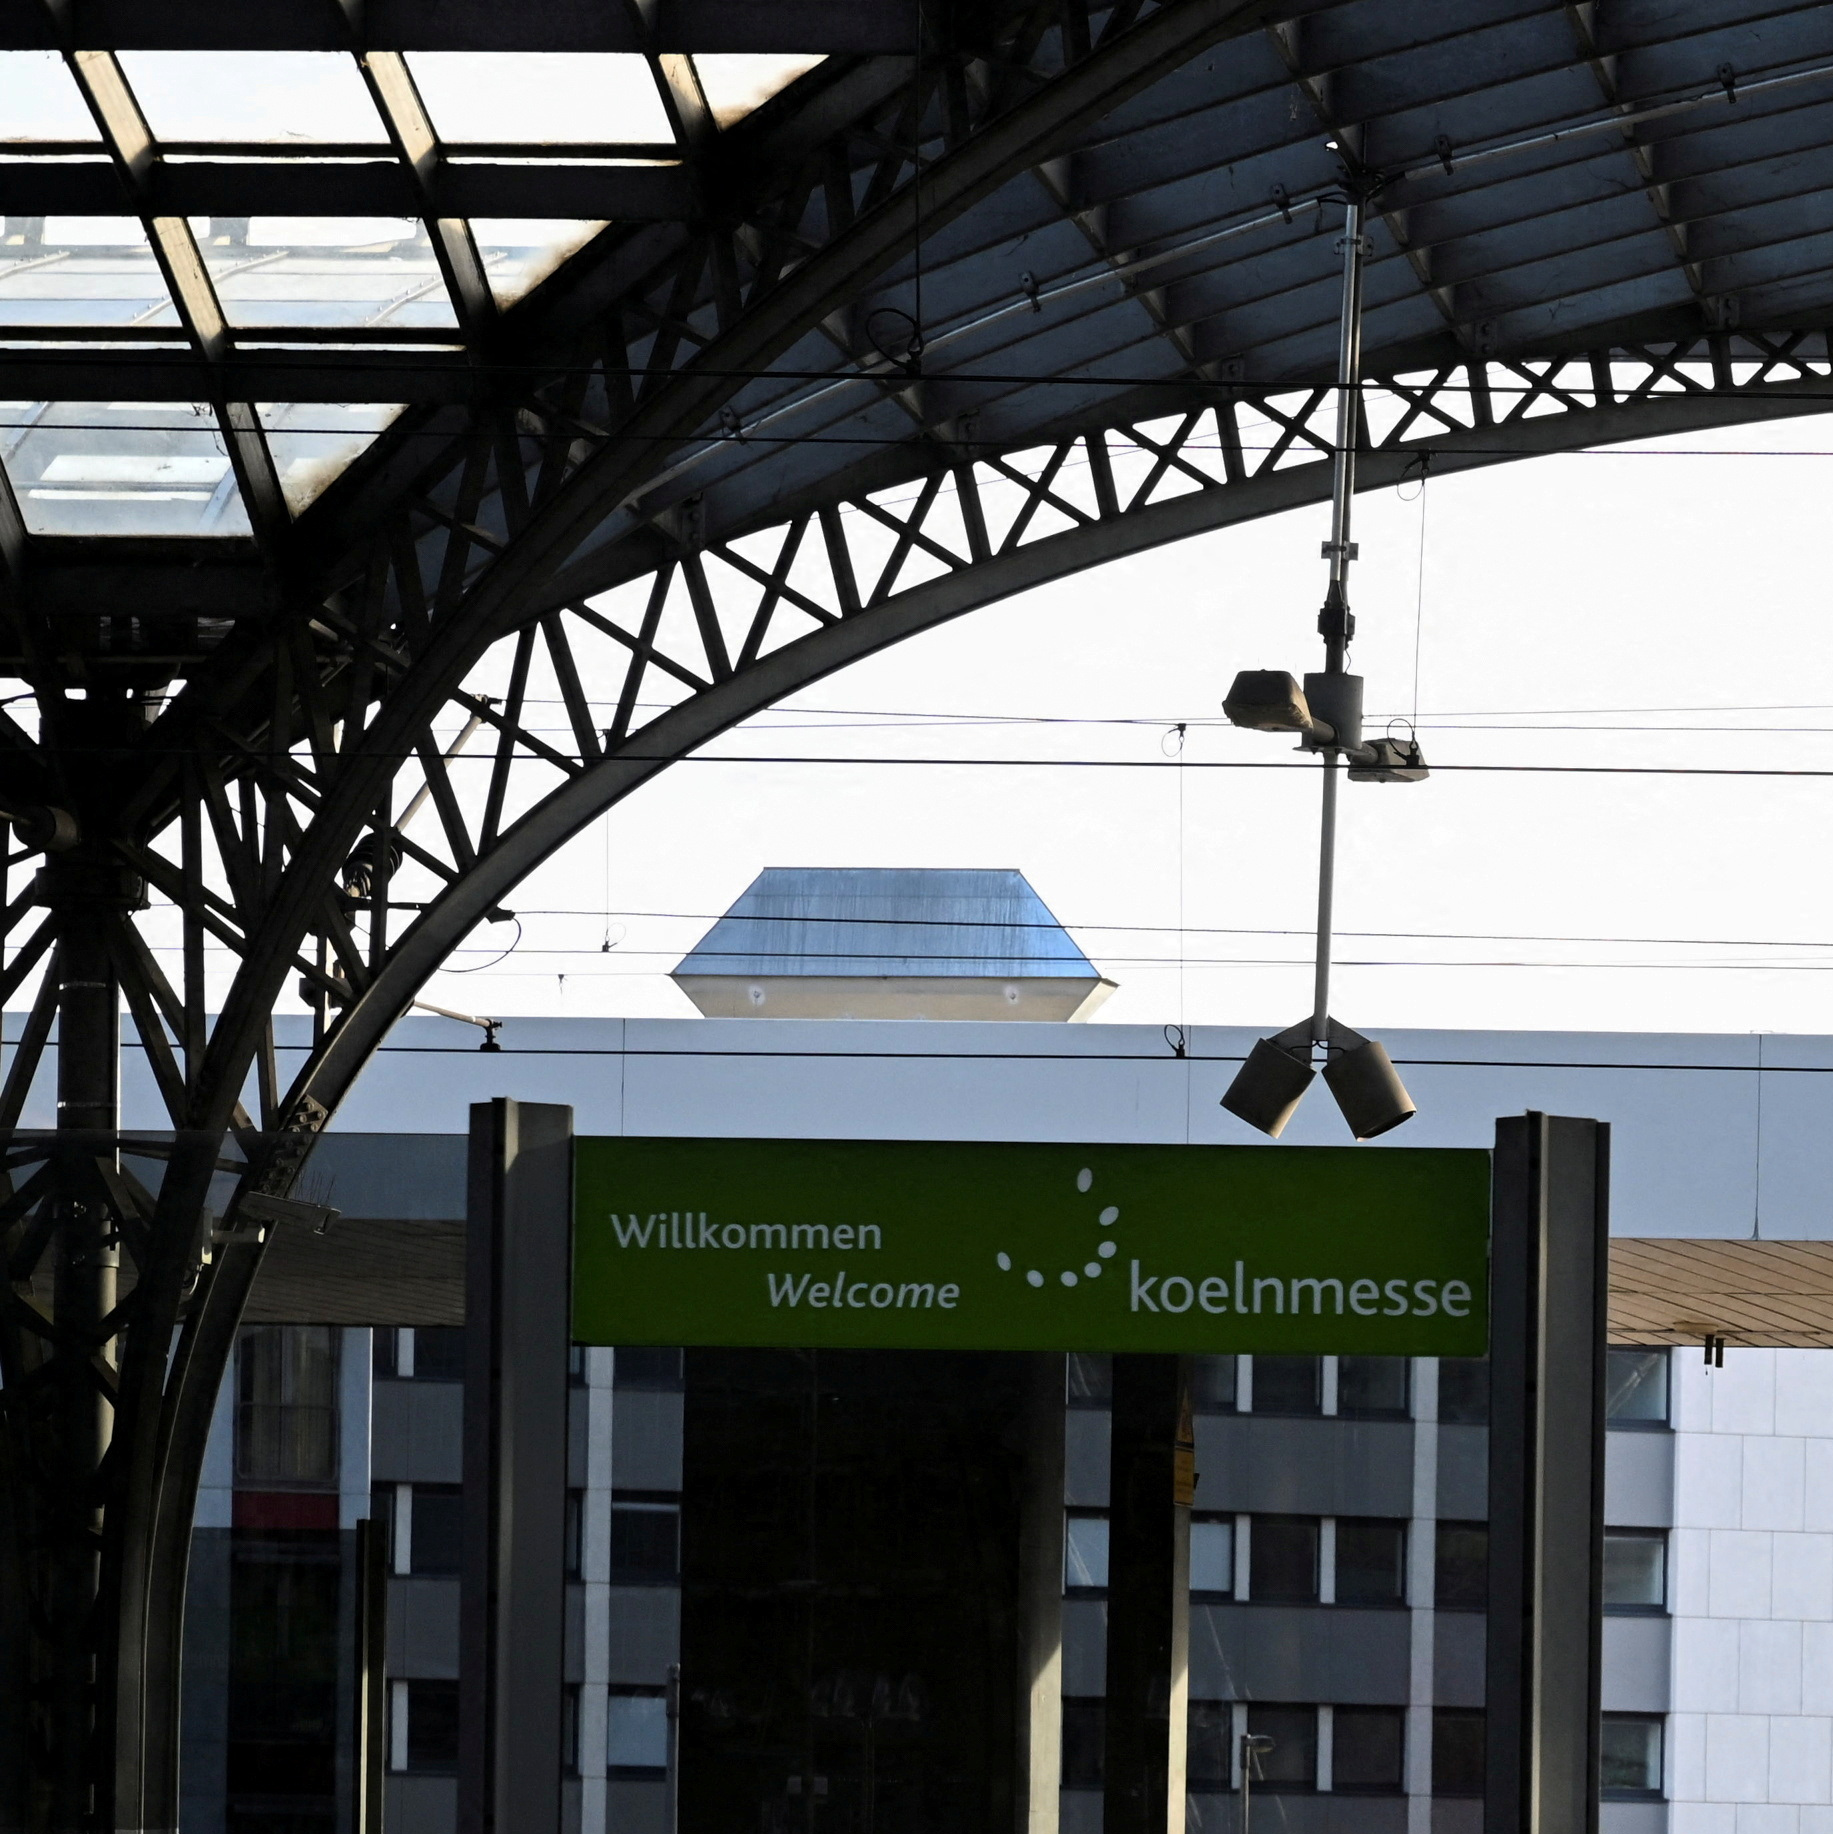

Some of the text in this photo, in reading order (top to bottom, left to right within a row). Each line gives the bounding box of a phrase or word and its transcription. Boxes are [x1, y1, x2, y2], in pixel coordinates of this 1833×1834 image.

[610, 1211, 883, 1252] Willkommen
[766, 1271, 961, 1311] Welcome
[1129, 1260, 1471, 1320] koelnmesse
